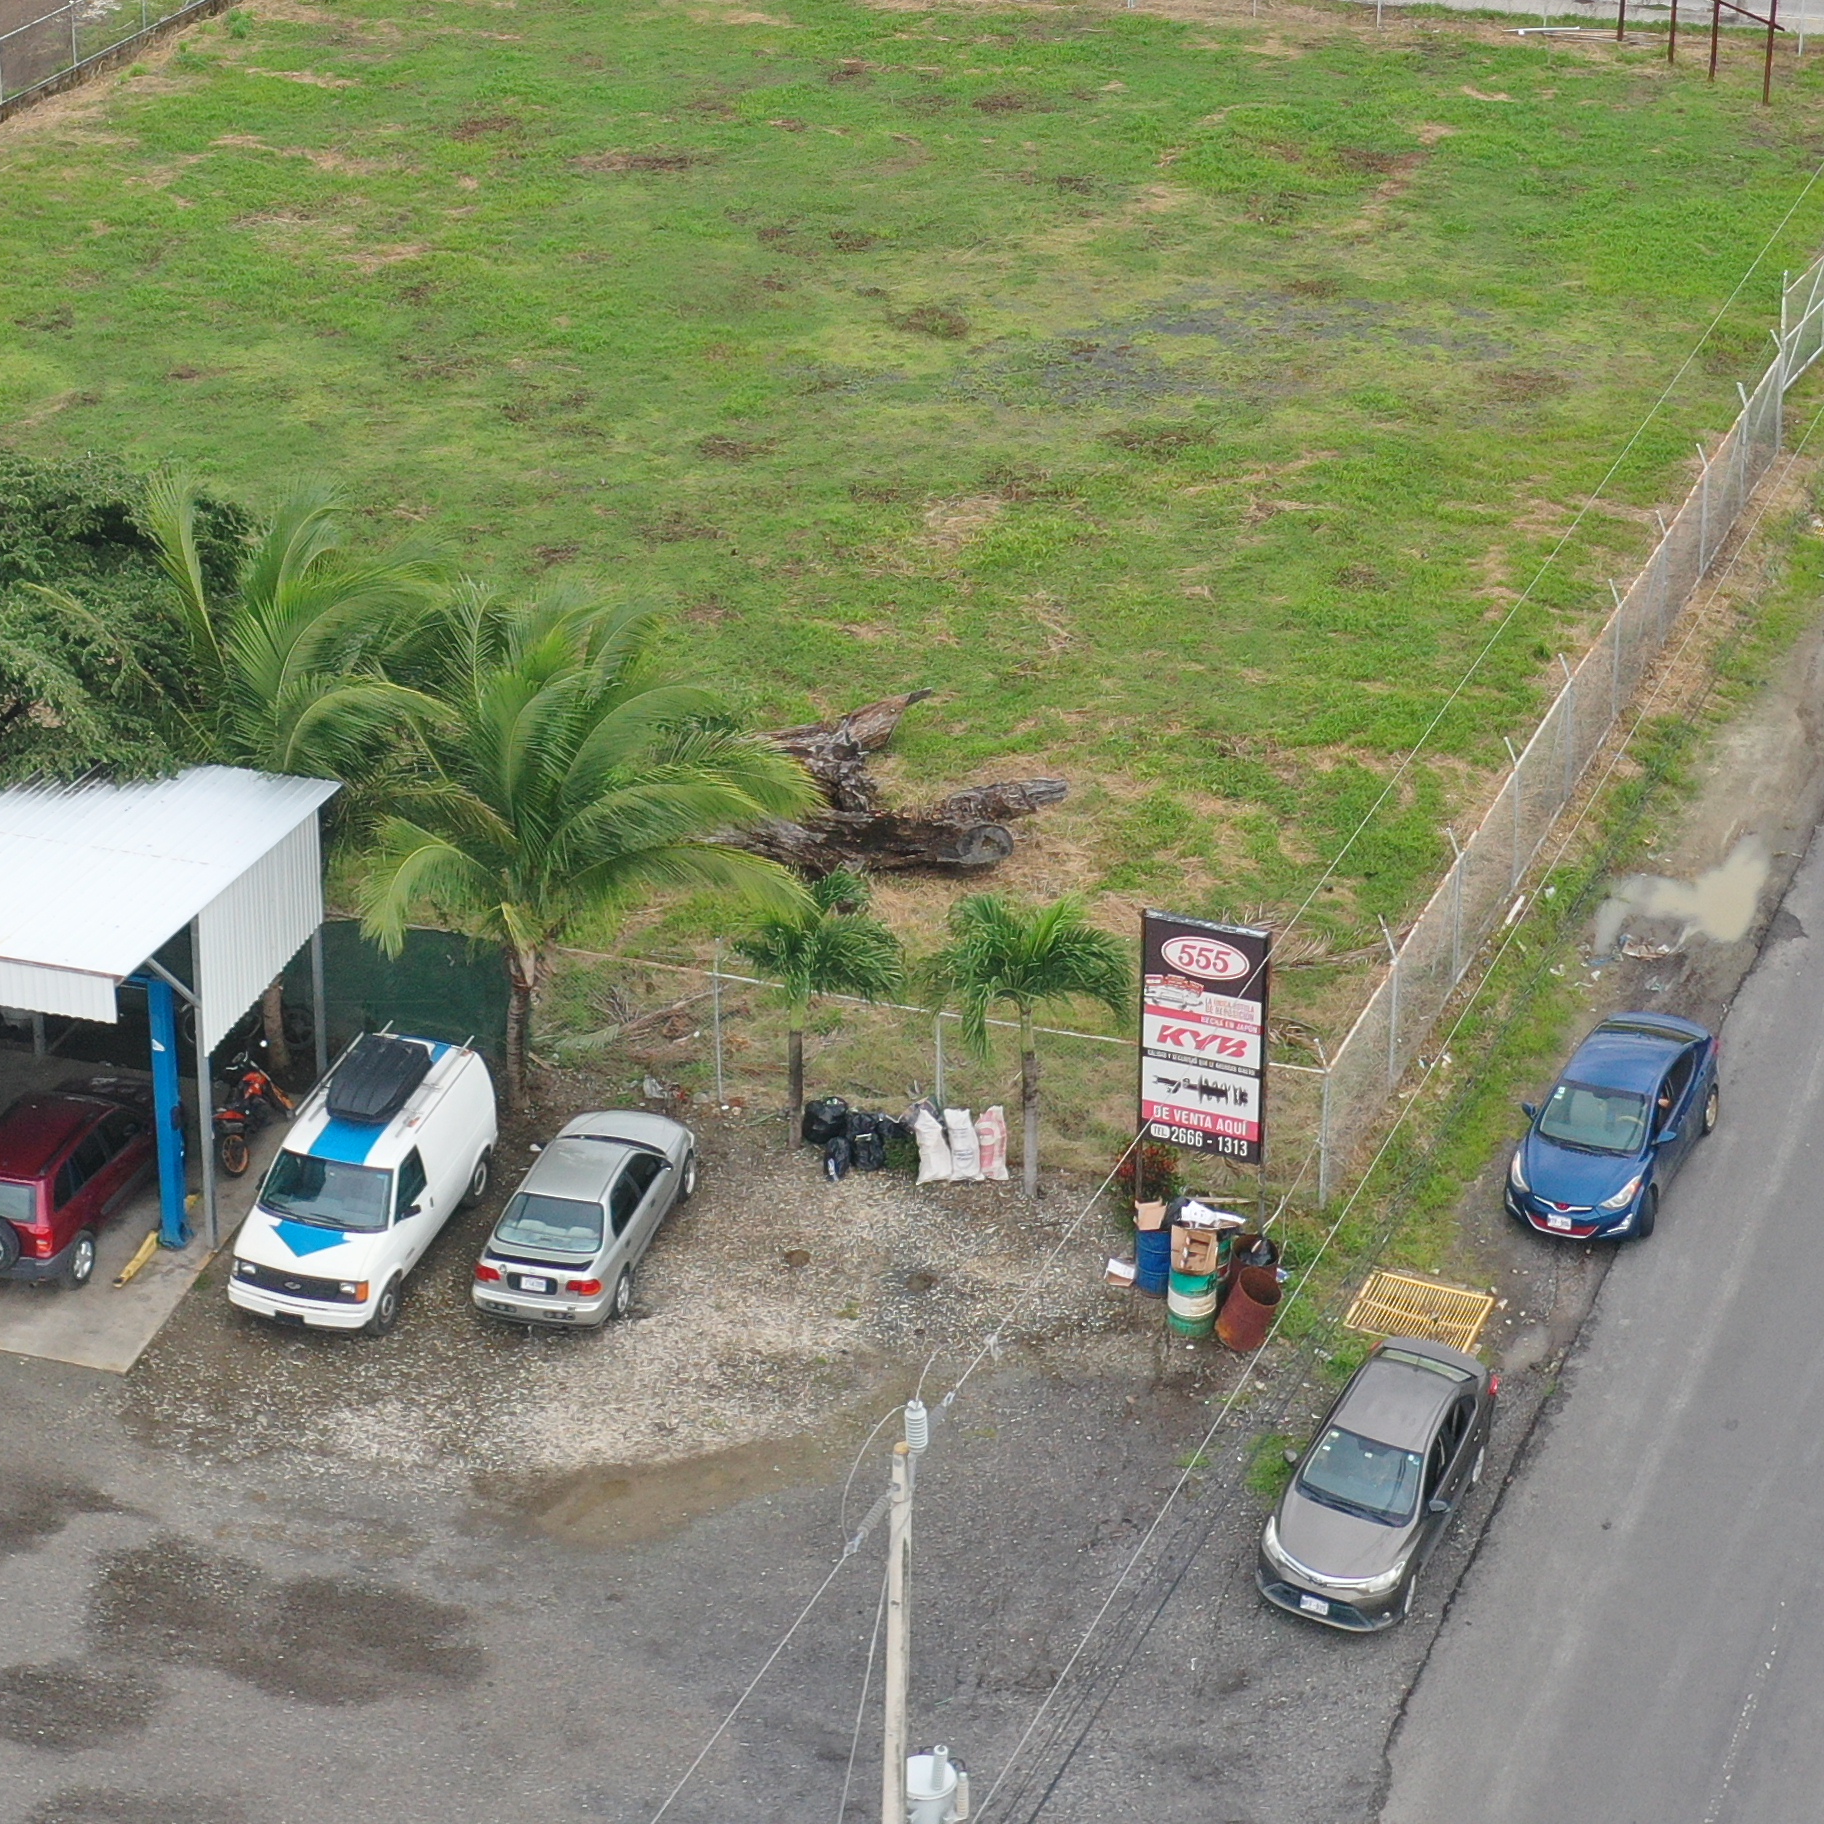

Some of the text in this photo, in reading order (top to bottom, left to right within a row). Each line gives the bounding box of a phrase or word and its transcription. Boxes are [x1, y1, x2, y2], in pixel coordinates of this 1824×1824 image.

[1178, 944, 1231, 974] 555
[1157, 1025, 1248, 1058] KYB
[1153, 1105, 1248, 1136] DE VENTA AQUÍ
[1171, 1126, 1203, 1147] 2666
[1217, 1136, 1248, 1156] 1313
